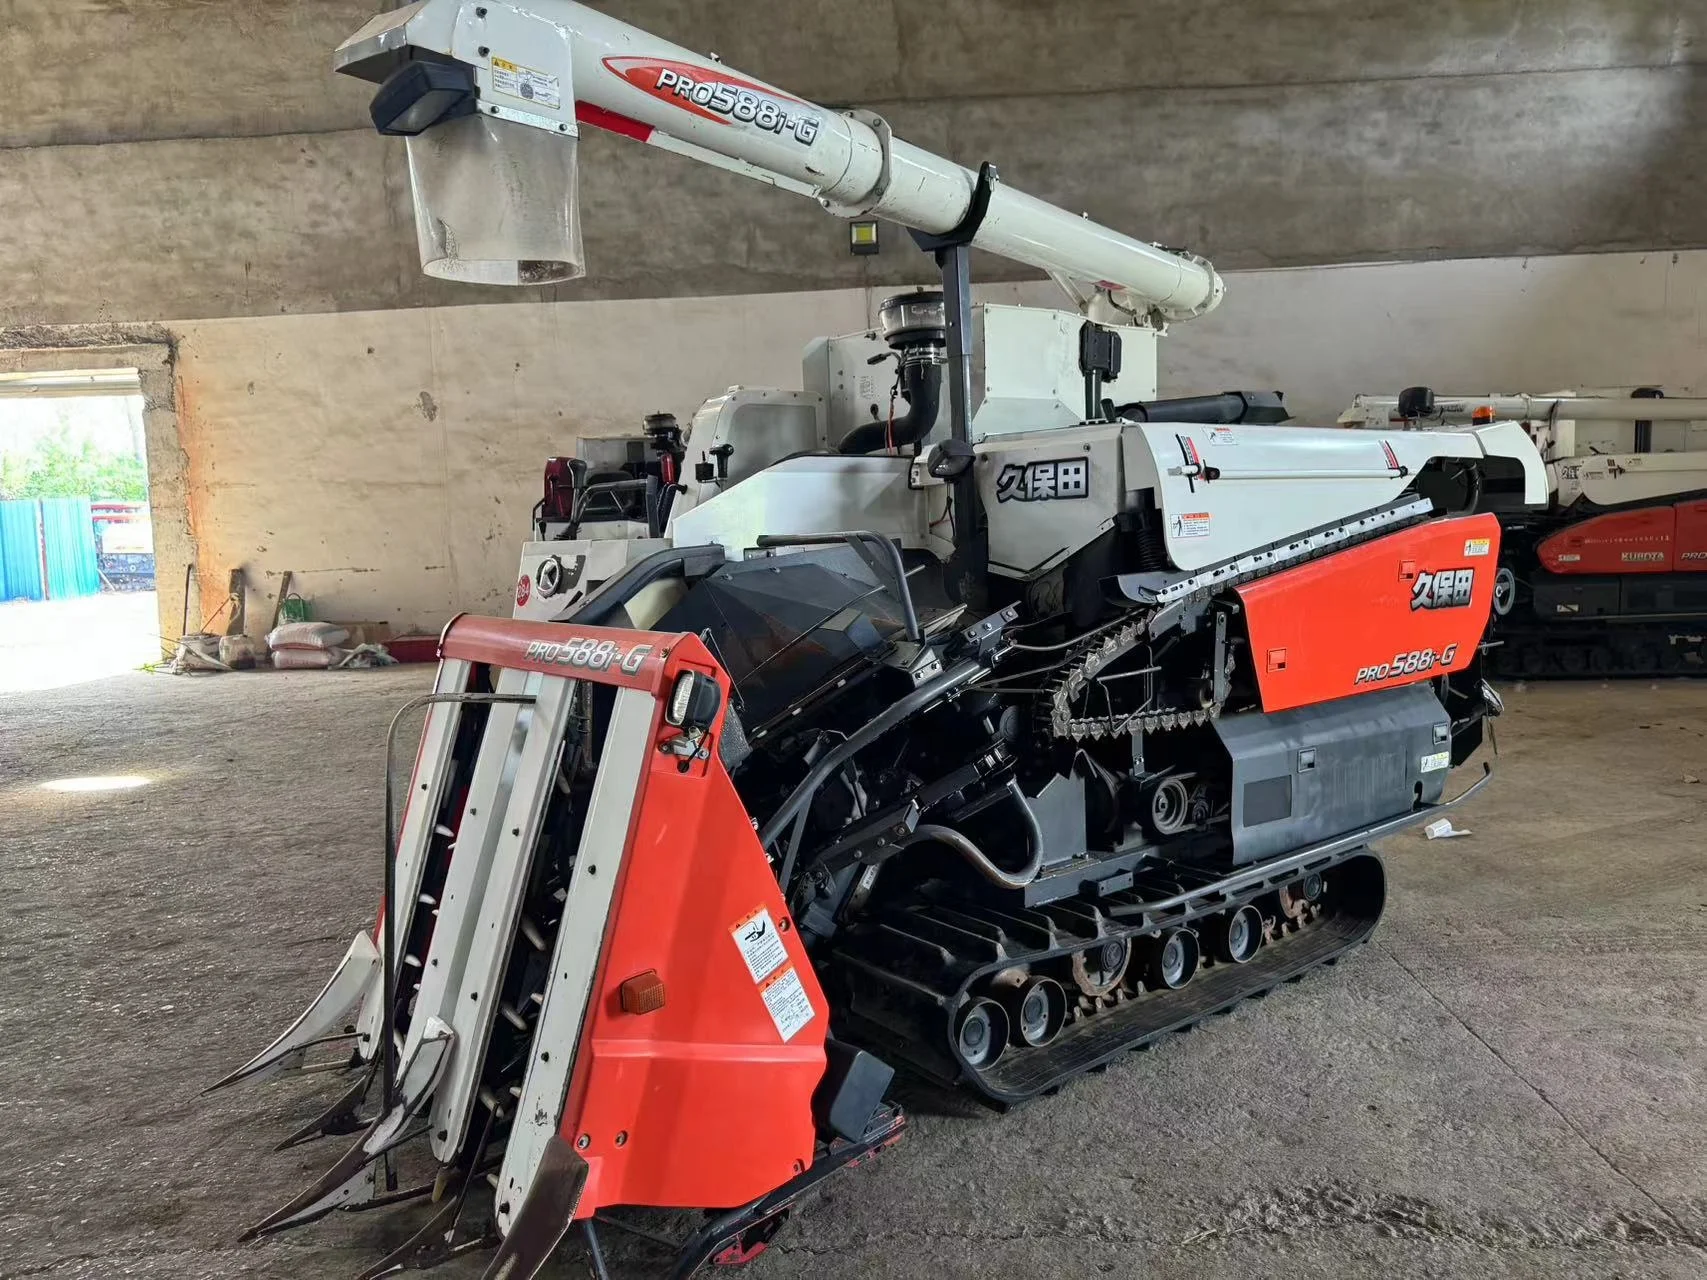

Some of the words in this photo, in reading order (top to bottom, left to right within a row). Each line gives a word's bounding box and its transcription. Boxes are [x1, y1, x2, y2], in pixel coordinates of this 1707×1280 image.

[996, 456, 1089, 504] 久保田
[1410, 567, 1475, 612] 久保田
